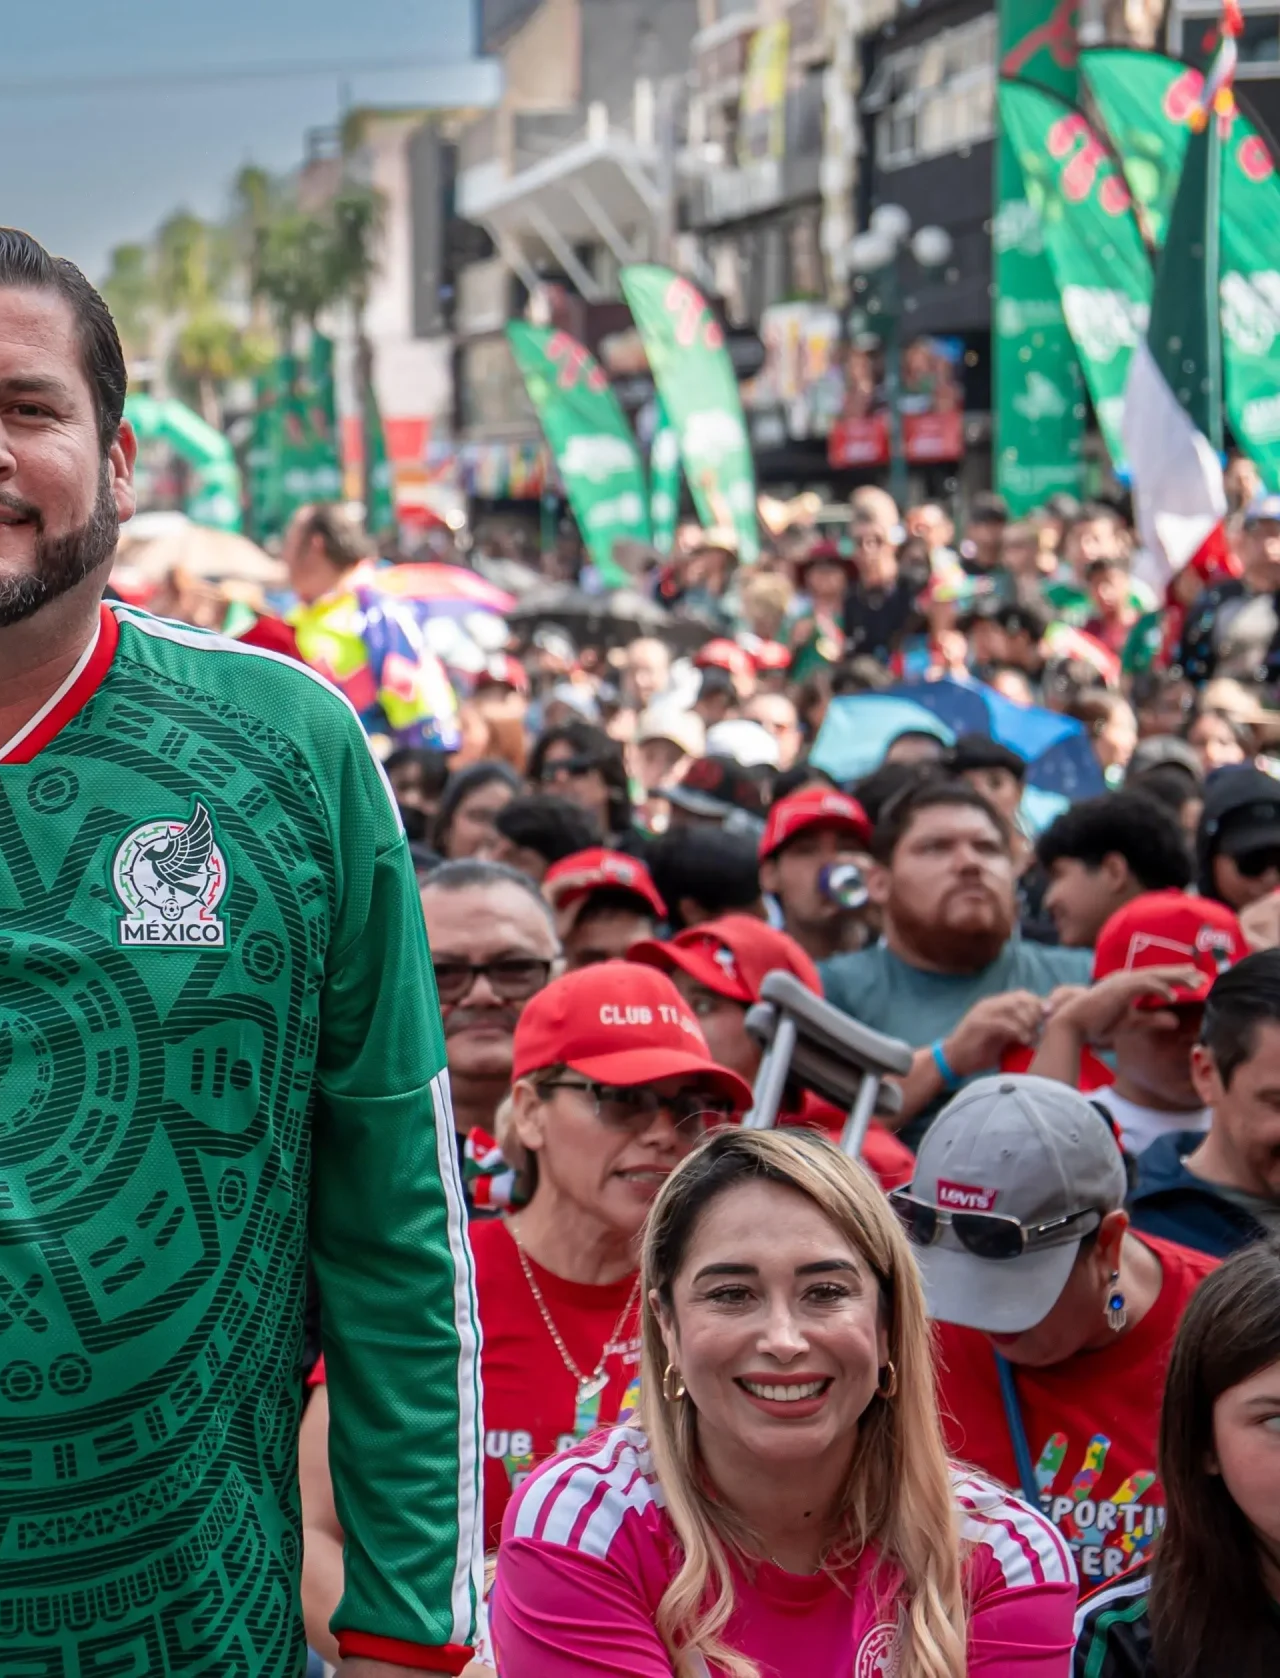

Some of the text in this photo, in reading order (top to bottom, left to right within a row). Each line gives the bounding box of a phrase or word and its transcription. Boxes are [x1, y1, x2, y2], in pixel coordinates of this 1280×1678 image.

[124, 920, 220, 942] MÉXICO
[599, 1003, 653, 1025] CLUB
[484, 1429, 533, 1459] UB
[1013, 1489, 1166, 1535] PORTI
